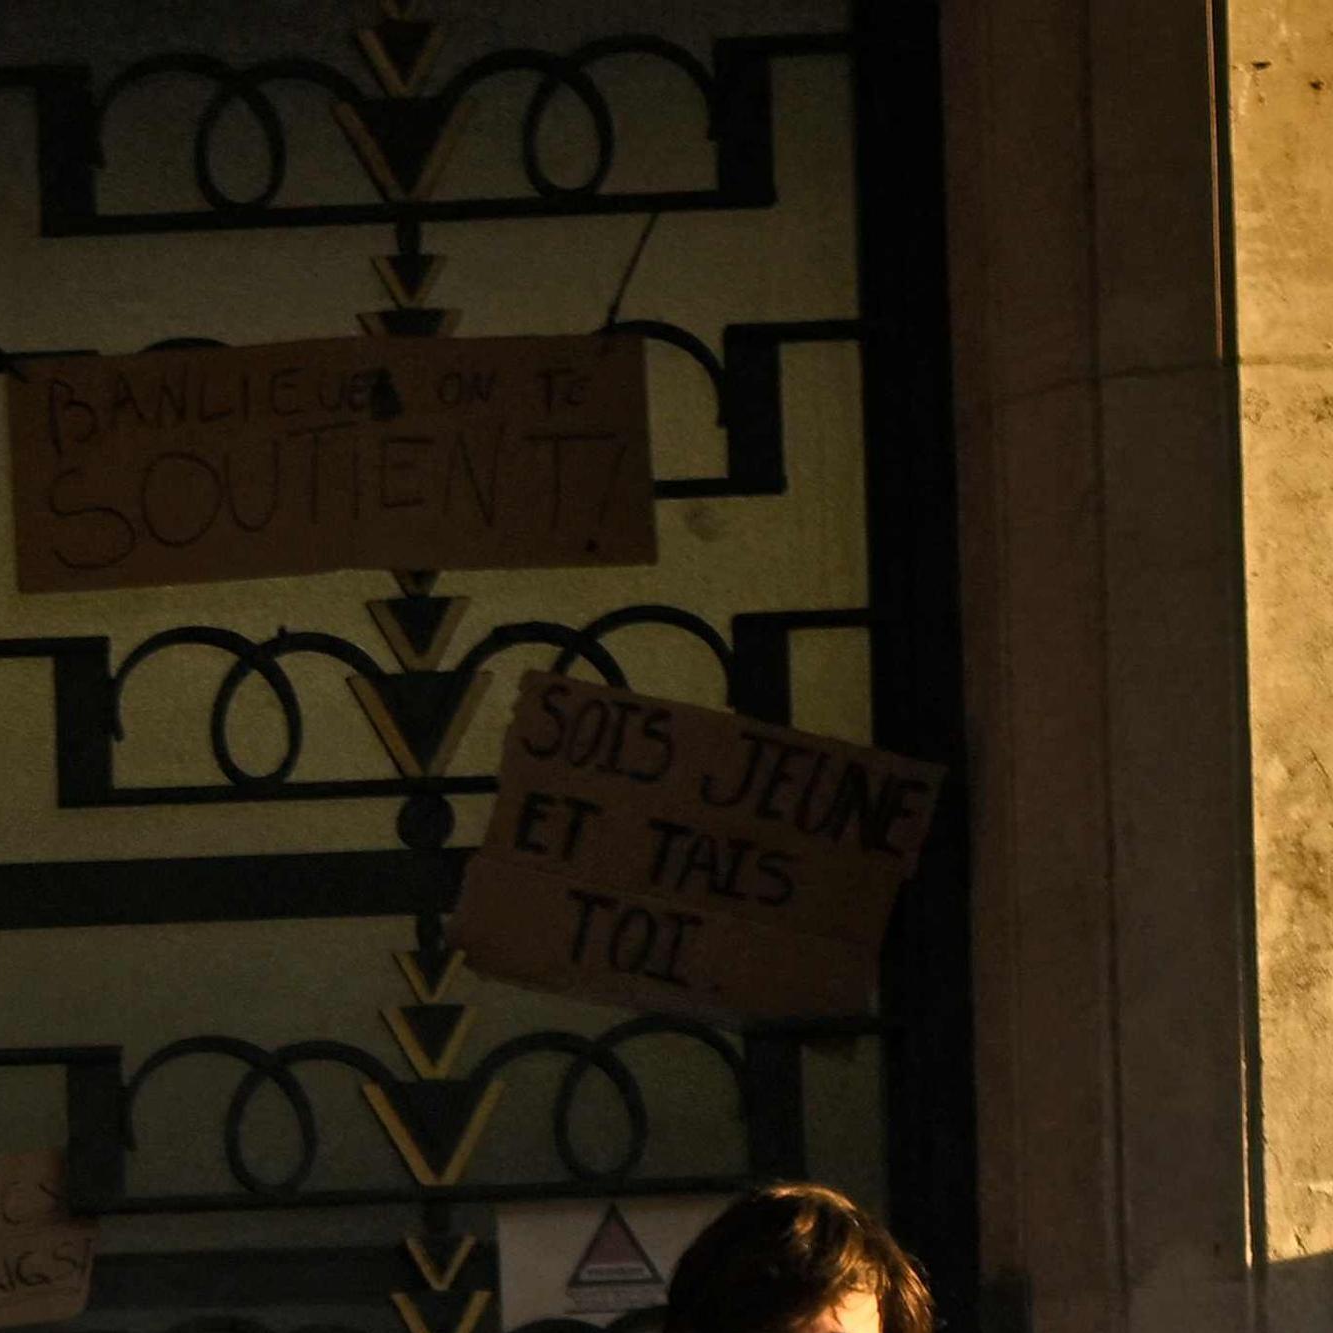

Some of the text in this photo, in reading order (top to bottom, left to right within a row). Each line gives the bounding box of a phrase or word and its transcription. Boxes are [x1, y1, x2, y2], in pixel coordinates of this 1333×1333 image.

[519, 684, 933, 858] SOIS JEUNE
[515, 792, 797, 908] ET TAIS
